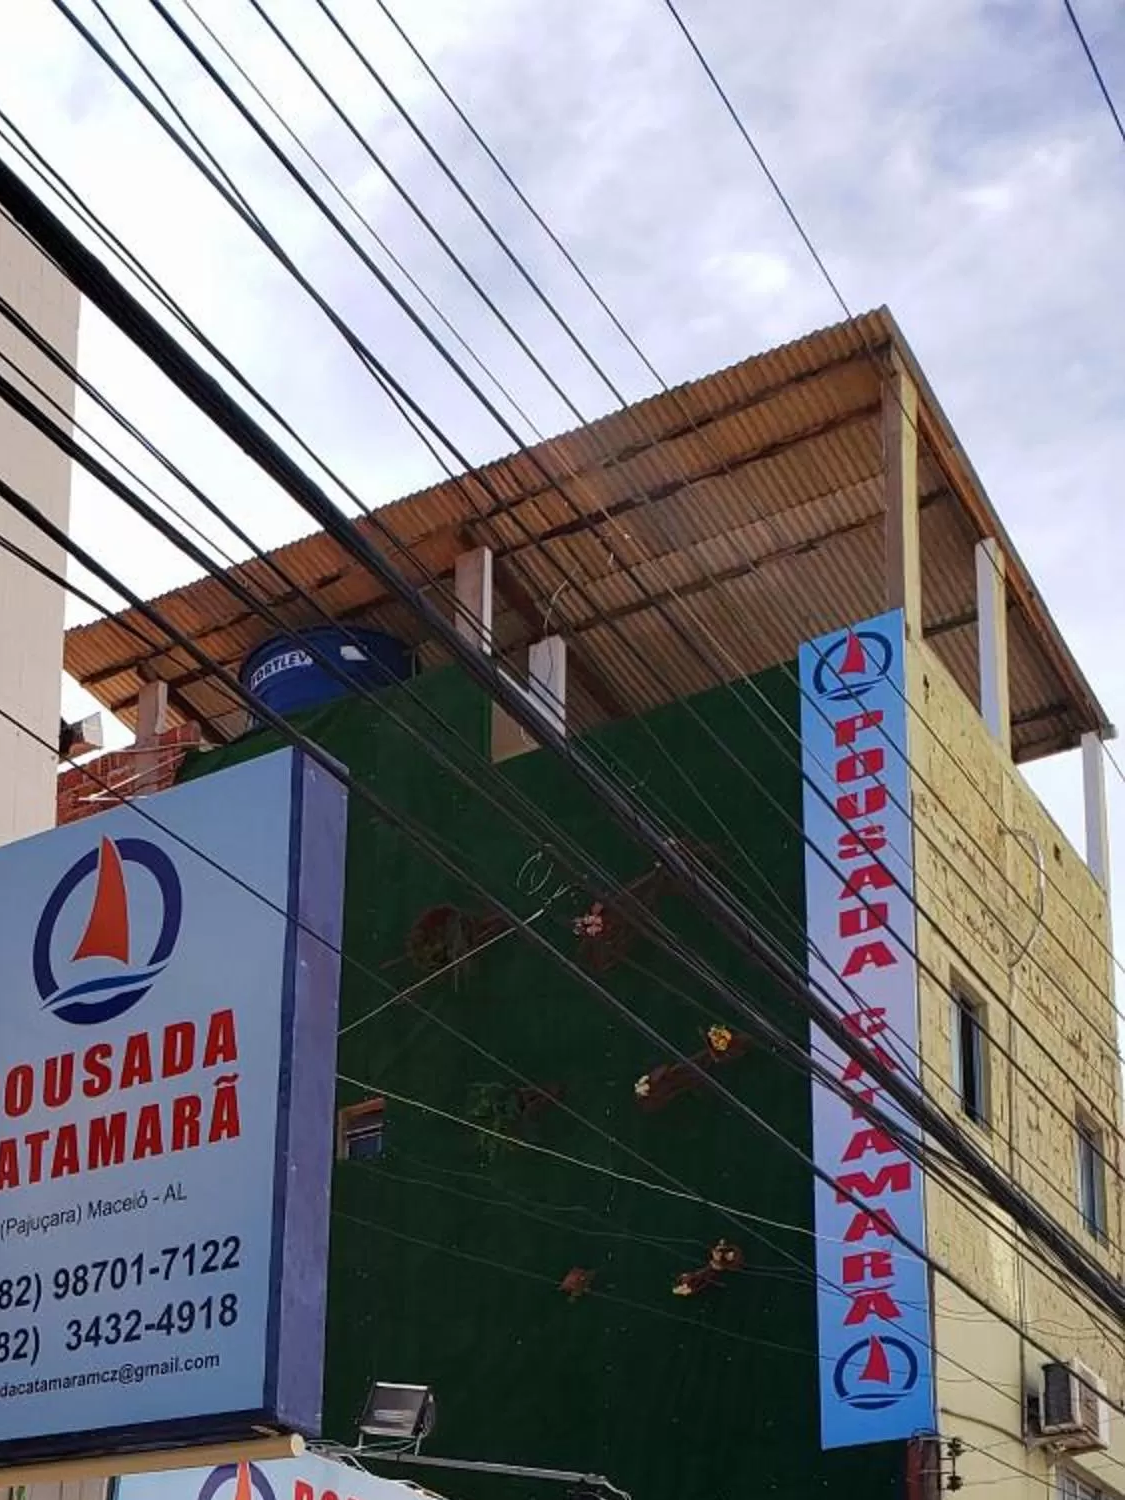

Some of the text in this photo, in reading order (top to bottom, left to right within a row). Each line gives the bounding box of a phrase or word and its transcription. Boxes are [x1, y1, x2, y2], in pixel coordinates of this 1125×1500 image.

[834, 709, 898, 977] POUSADA
[0, 1202, 82, 1241] (Pajuçara)
[88, 1192, 148, 1220] Maceió
[163, 1183, 188, 1204] AL
[53, 1235, 241, 1301] 98701-7122
[65, 1293, 238, 1352] 3432-4918
